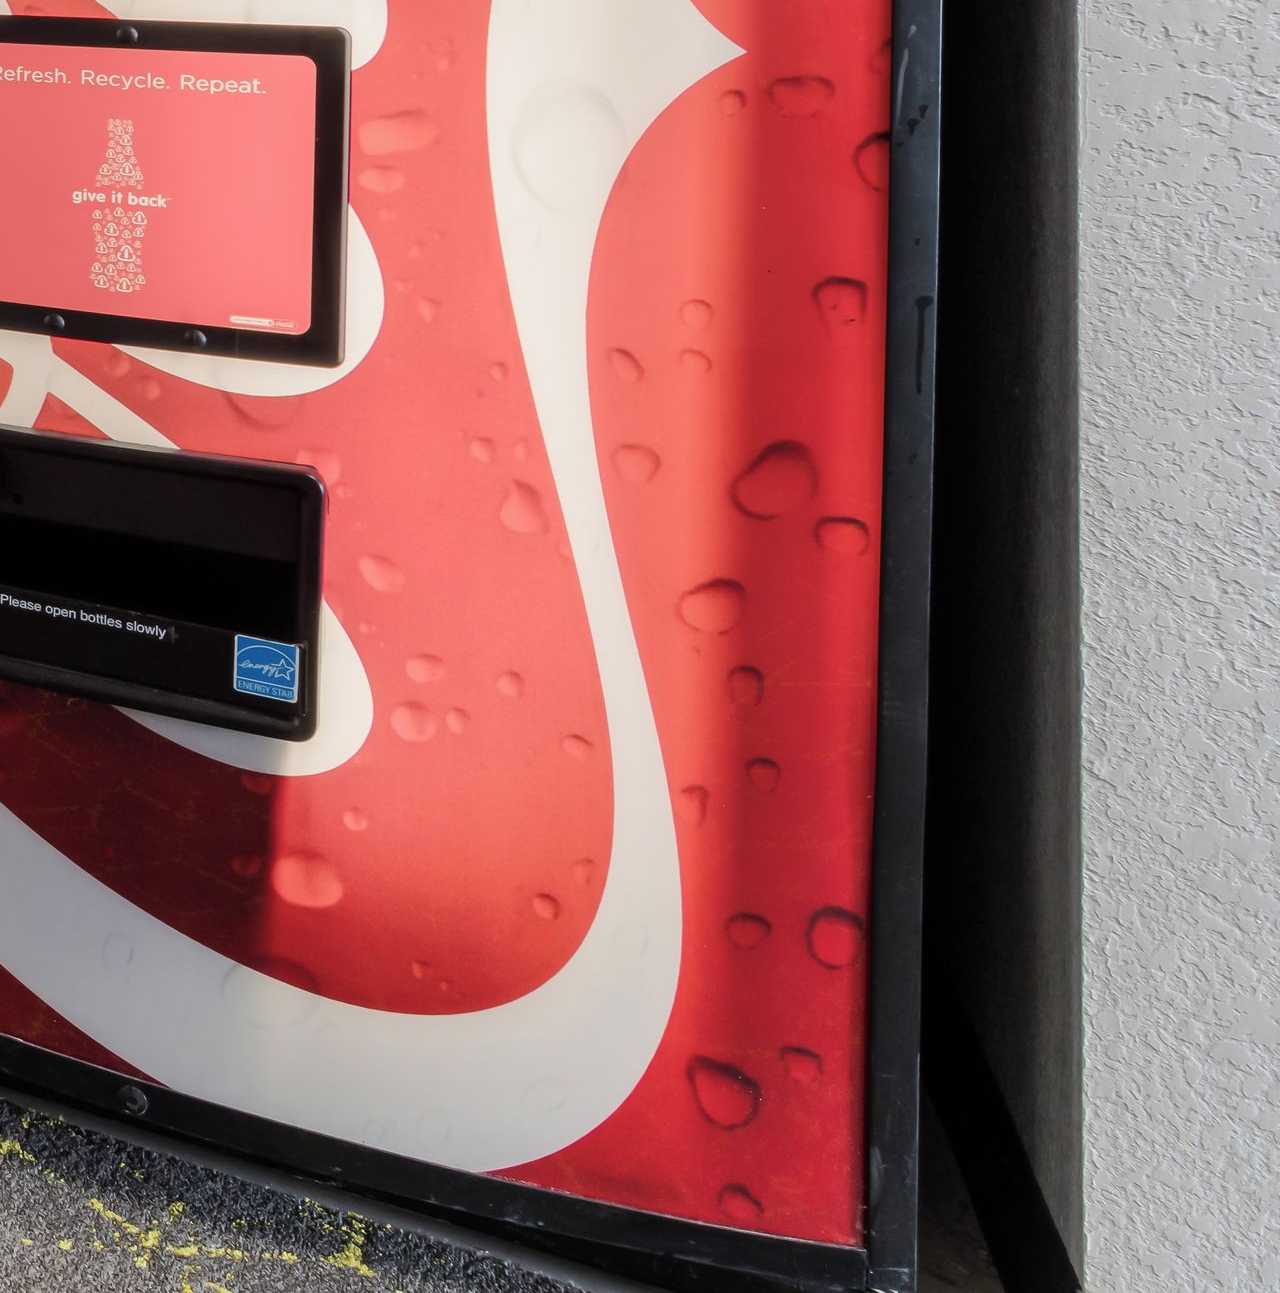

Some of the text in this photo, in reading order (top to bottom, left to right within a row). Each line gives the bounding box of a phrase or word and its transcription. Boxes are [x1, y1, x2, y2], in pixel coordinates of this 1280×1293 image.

[80, 69, 171, 90] Recycle.
[180, 74, 267, 95] Repeat.
[72, 189, 167, 208] give it back
[0, 593, 166, 640] Please open bottles slowly
[239, 660, 276, 676] energy
[238, 680, 293, 698] ENERGY STAR
